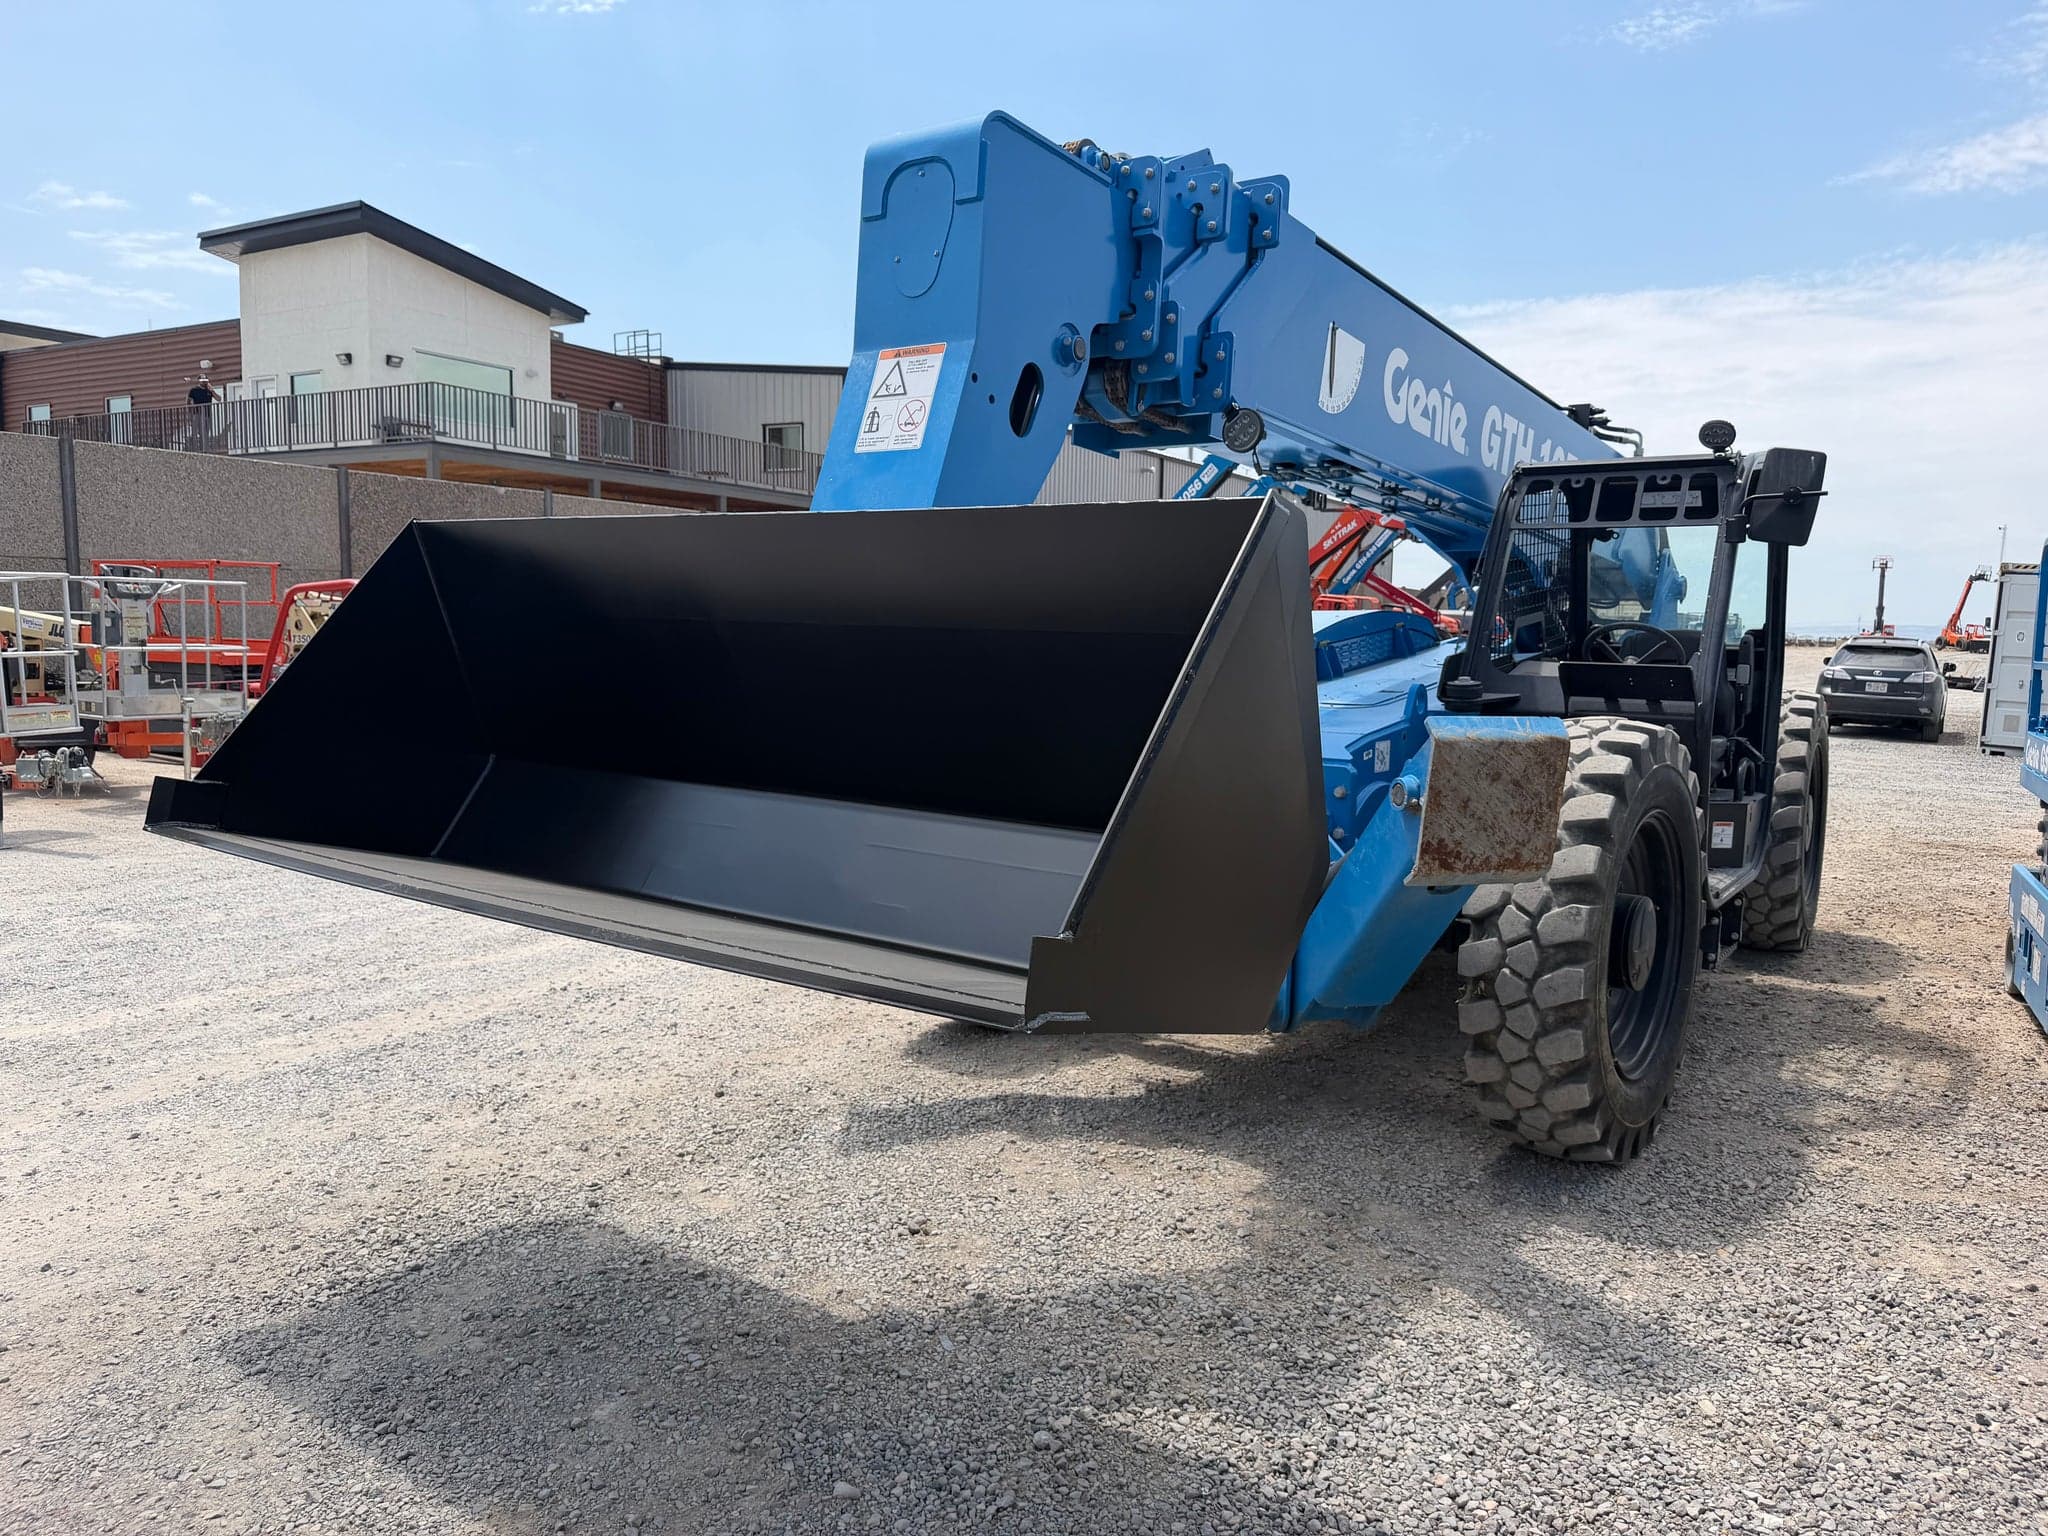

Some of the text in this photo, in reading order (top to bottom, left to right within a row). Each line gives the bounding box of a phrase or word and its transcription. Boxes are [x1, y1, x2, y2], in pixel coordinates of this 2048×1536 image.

[902, 347, 930, 357] WARNING
[1384, 347, 1468, 456] Genie
[1178, 478, 1203, 500] 056
[1322, 519, 1358, 550] SKYTRAK
